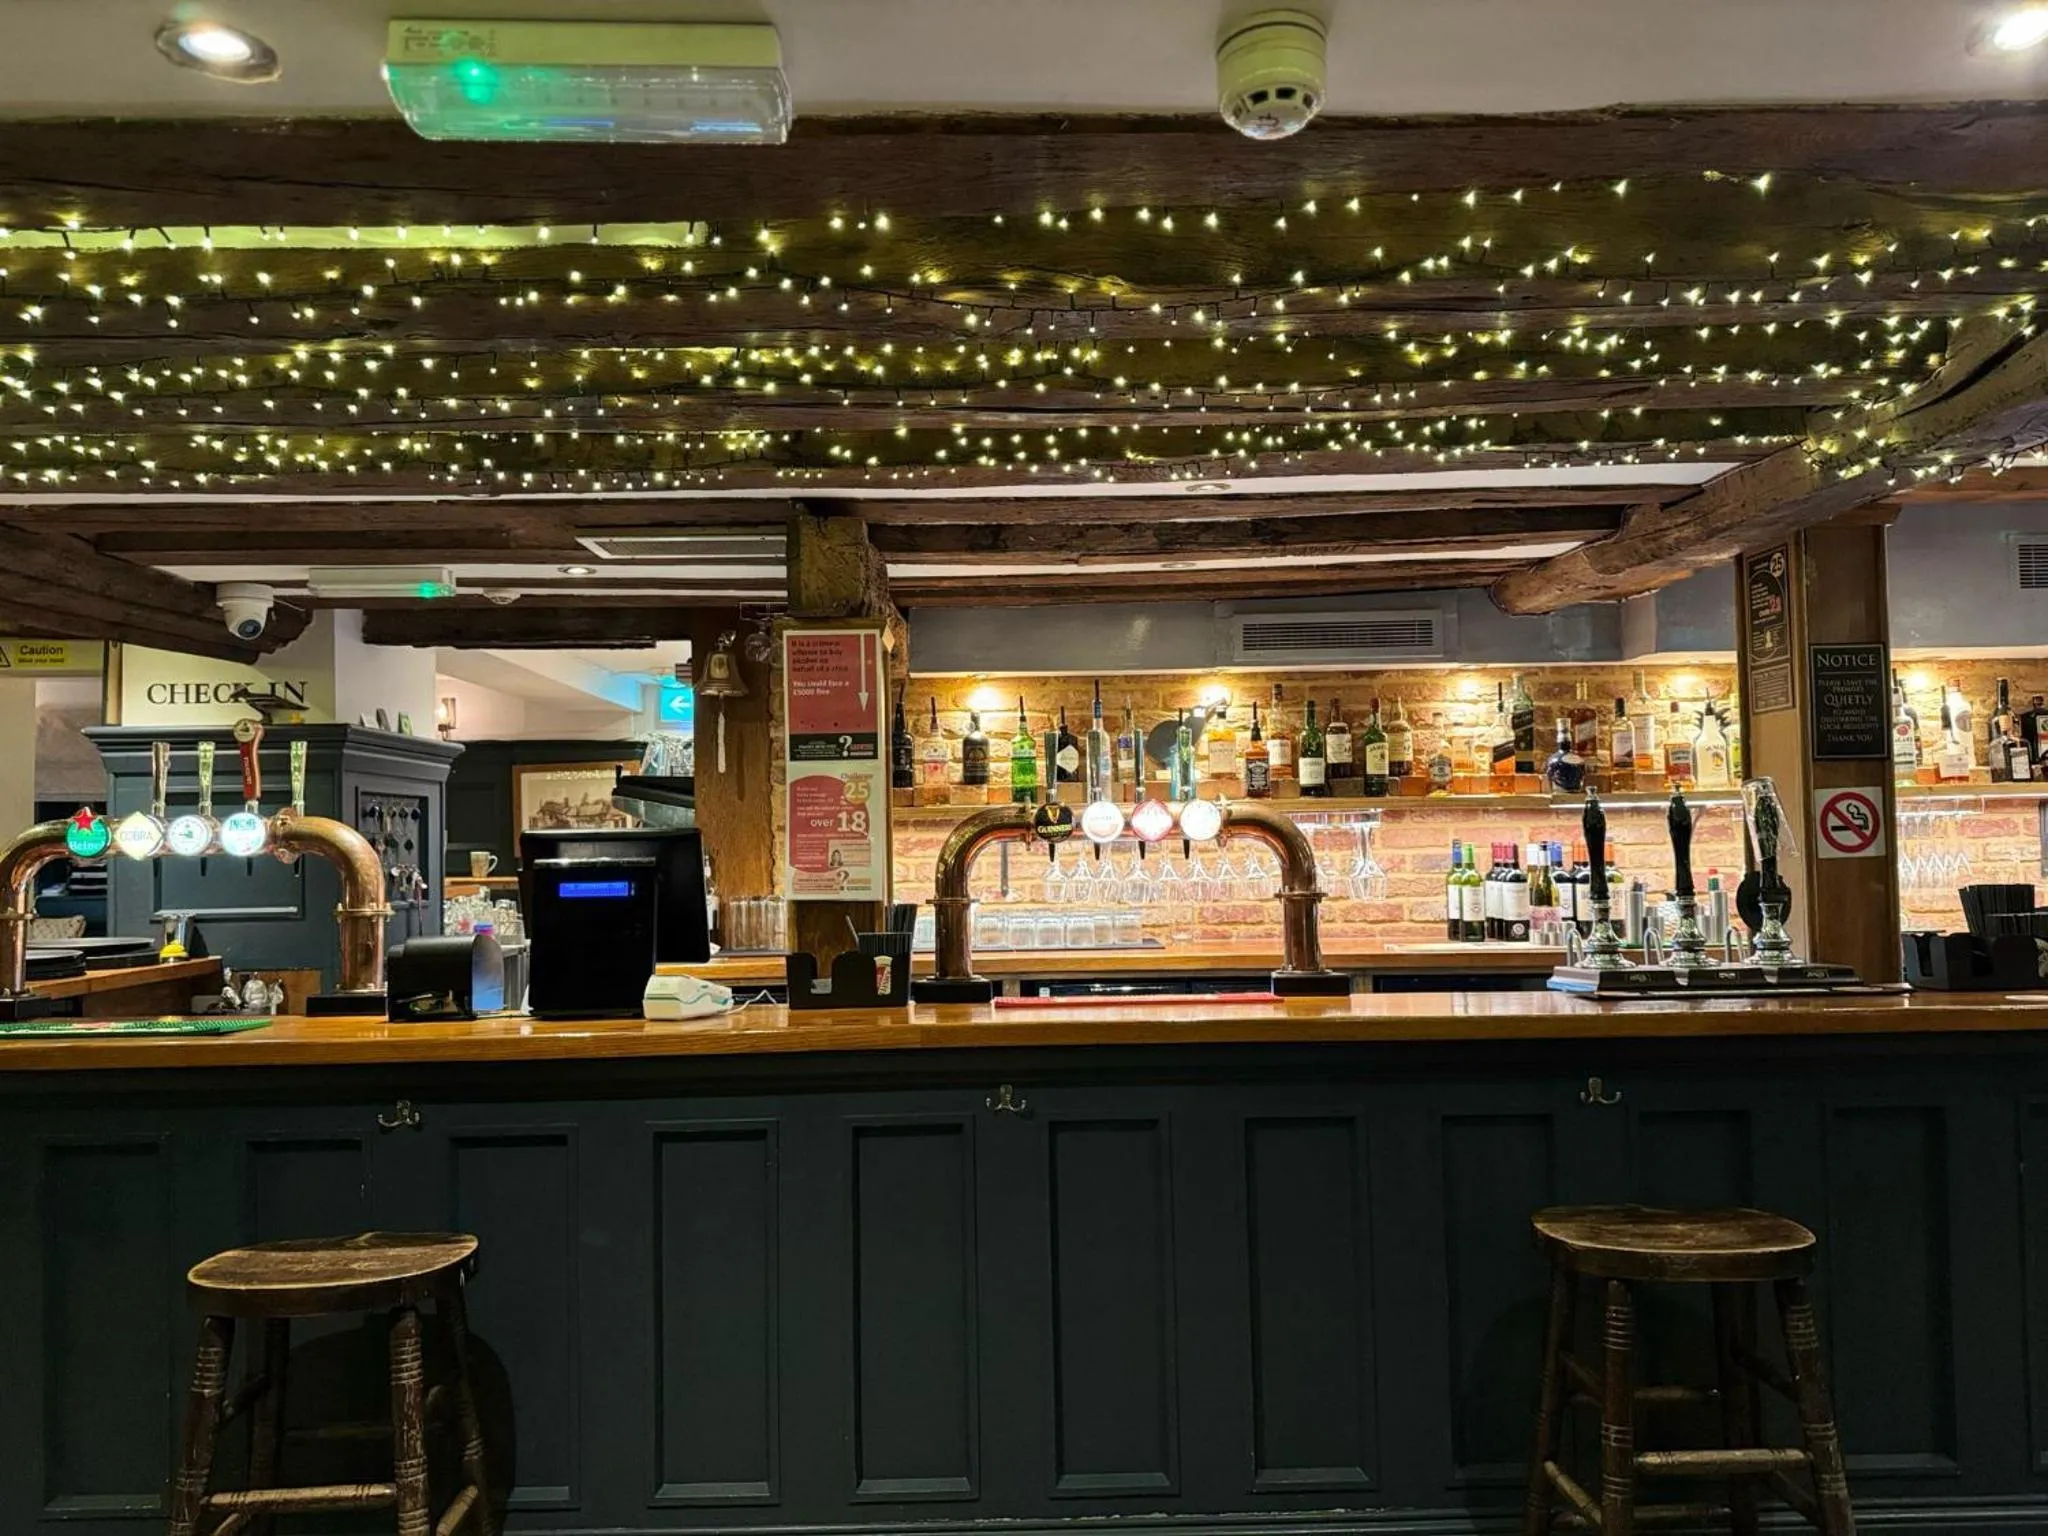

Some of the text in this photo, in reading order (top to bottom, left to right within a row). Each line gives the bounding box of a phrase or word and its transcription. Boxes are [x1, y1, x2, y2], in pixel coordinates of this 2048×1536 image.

[20, 644, 64, 656] Caution
[1817, 652, 1877, 668] NOTICE
[146, 683, 255, 705] CHECK
[1823, 693, 1874, 708] QUIETLY
[1827, 733, 1873, 742] THANK YOU
[845, 780, 869, 799] 25
[810, 811, 868, 833] over 18
[1037, 824, 1073, 834] GUINNESS
[119, 829, 157, 842] COBRA
[69, 840, 106, 850] Heine
